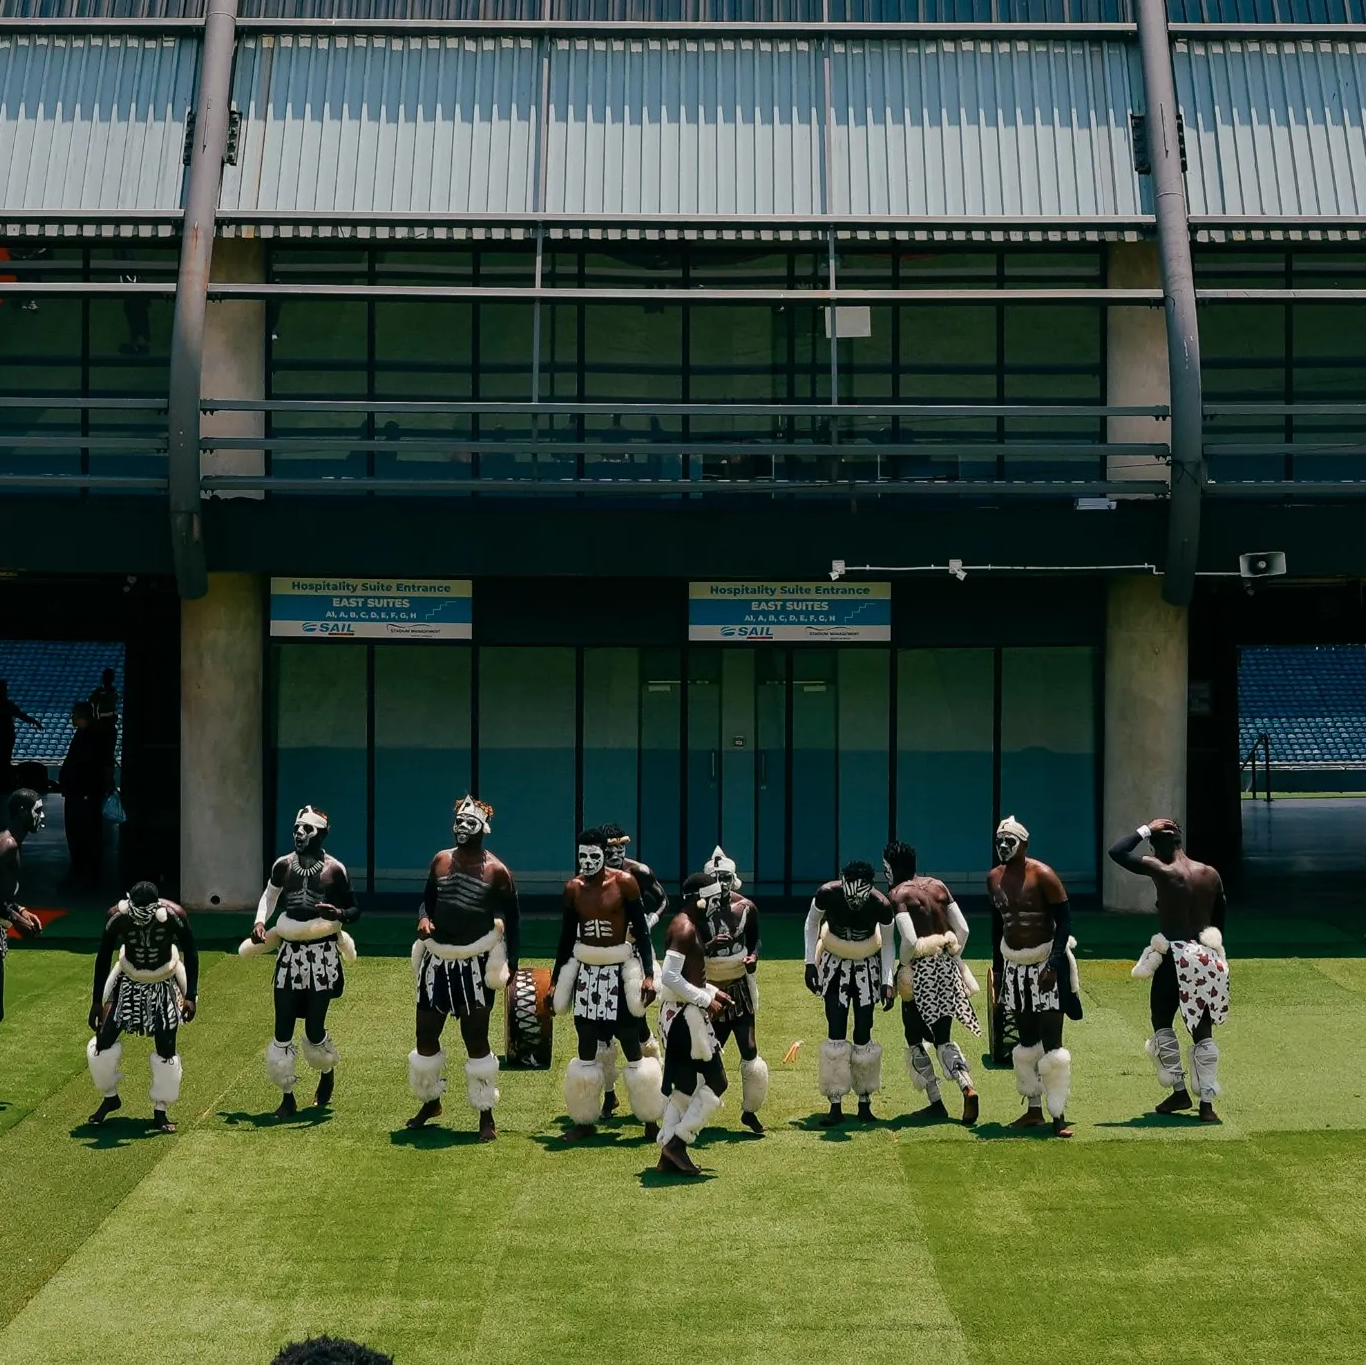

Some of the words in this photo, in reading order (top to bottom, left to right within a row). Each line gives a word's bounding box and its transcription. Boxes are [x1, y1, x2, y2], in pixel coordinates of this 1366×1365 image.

[291, 580, 358, 593] Hospitality
[361, 582, 392, 592] Suite
[396, 582, 451, 593] Entrance
[710, 584, 776, 596] Hospitality
[780, 585, 811, 594] Suite
[815, 585, 871, 595] Entrance
[332, 597, 364, 607] EAST
[367, 598, 410, 608] SUITES
[751, 601, 783, 611] EAST
[786, 601, 829, 611] SUITES
[319, 623, 355, 633] SAIL
[738, 626, 774, 636] SAIL
